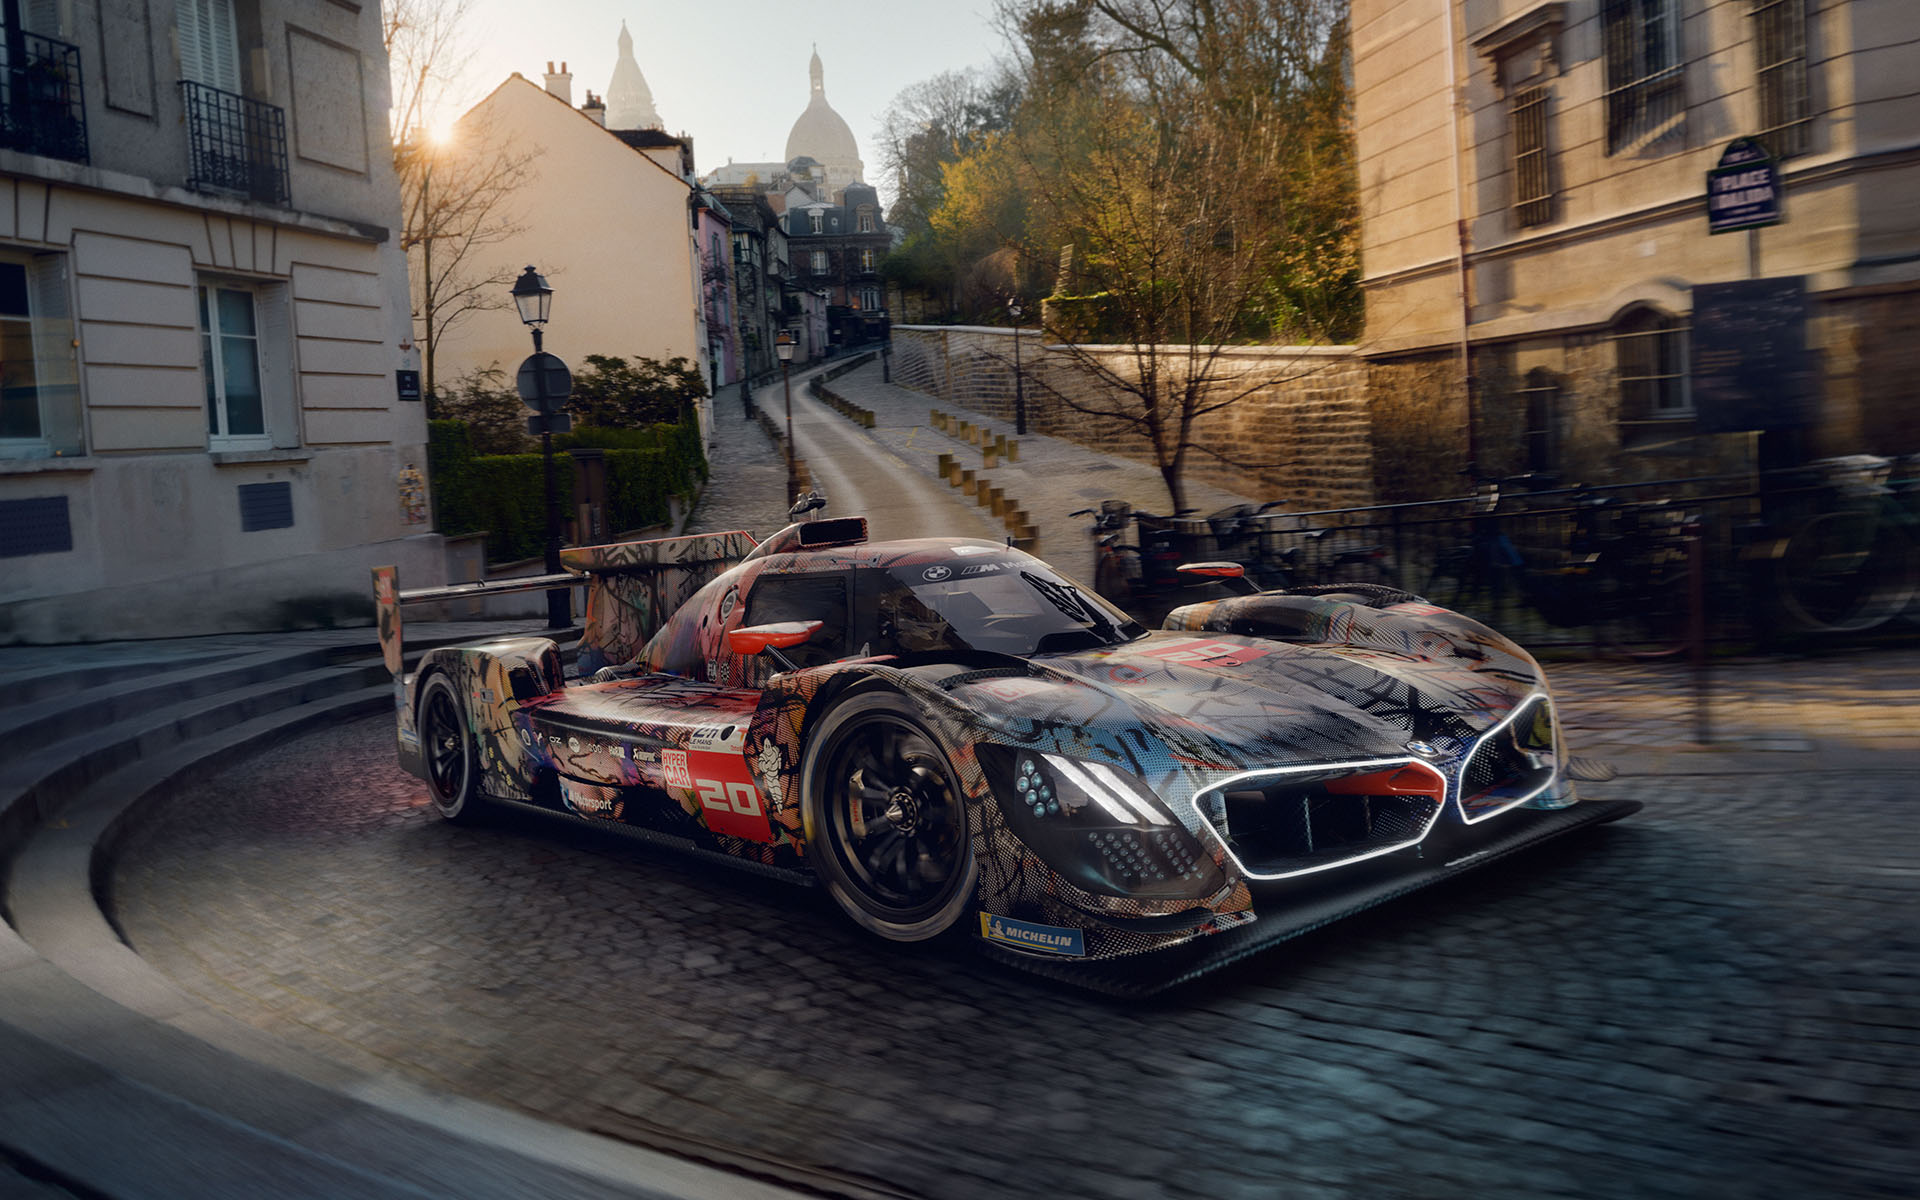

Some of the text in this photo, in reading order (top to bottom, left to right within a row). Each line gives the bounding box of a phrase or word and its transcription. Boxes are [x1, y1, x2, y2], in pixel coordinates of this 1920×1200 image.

[662, 751, 686, 764] HYPER
[665, 764, 690, 788] CAR
[695, 778, 762, 817] 20
[1005, 926, 1073, 947] MICHELIN
